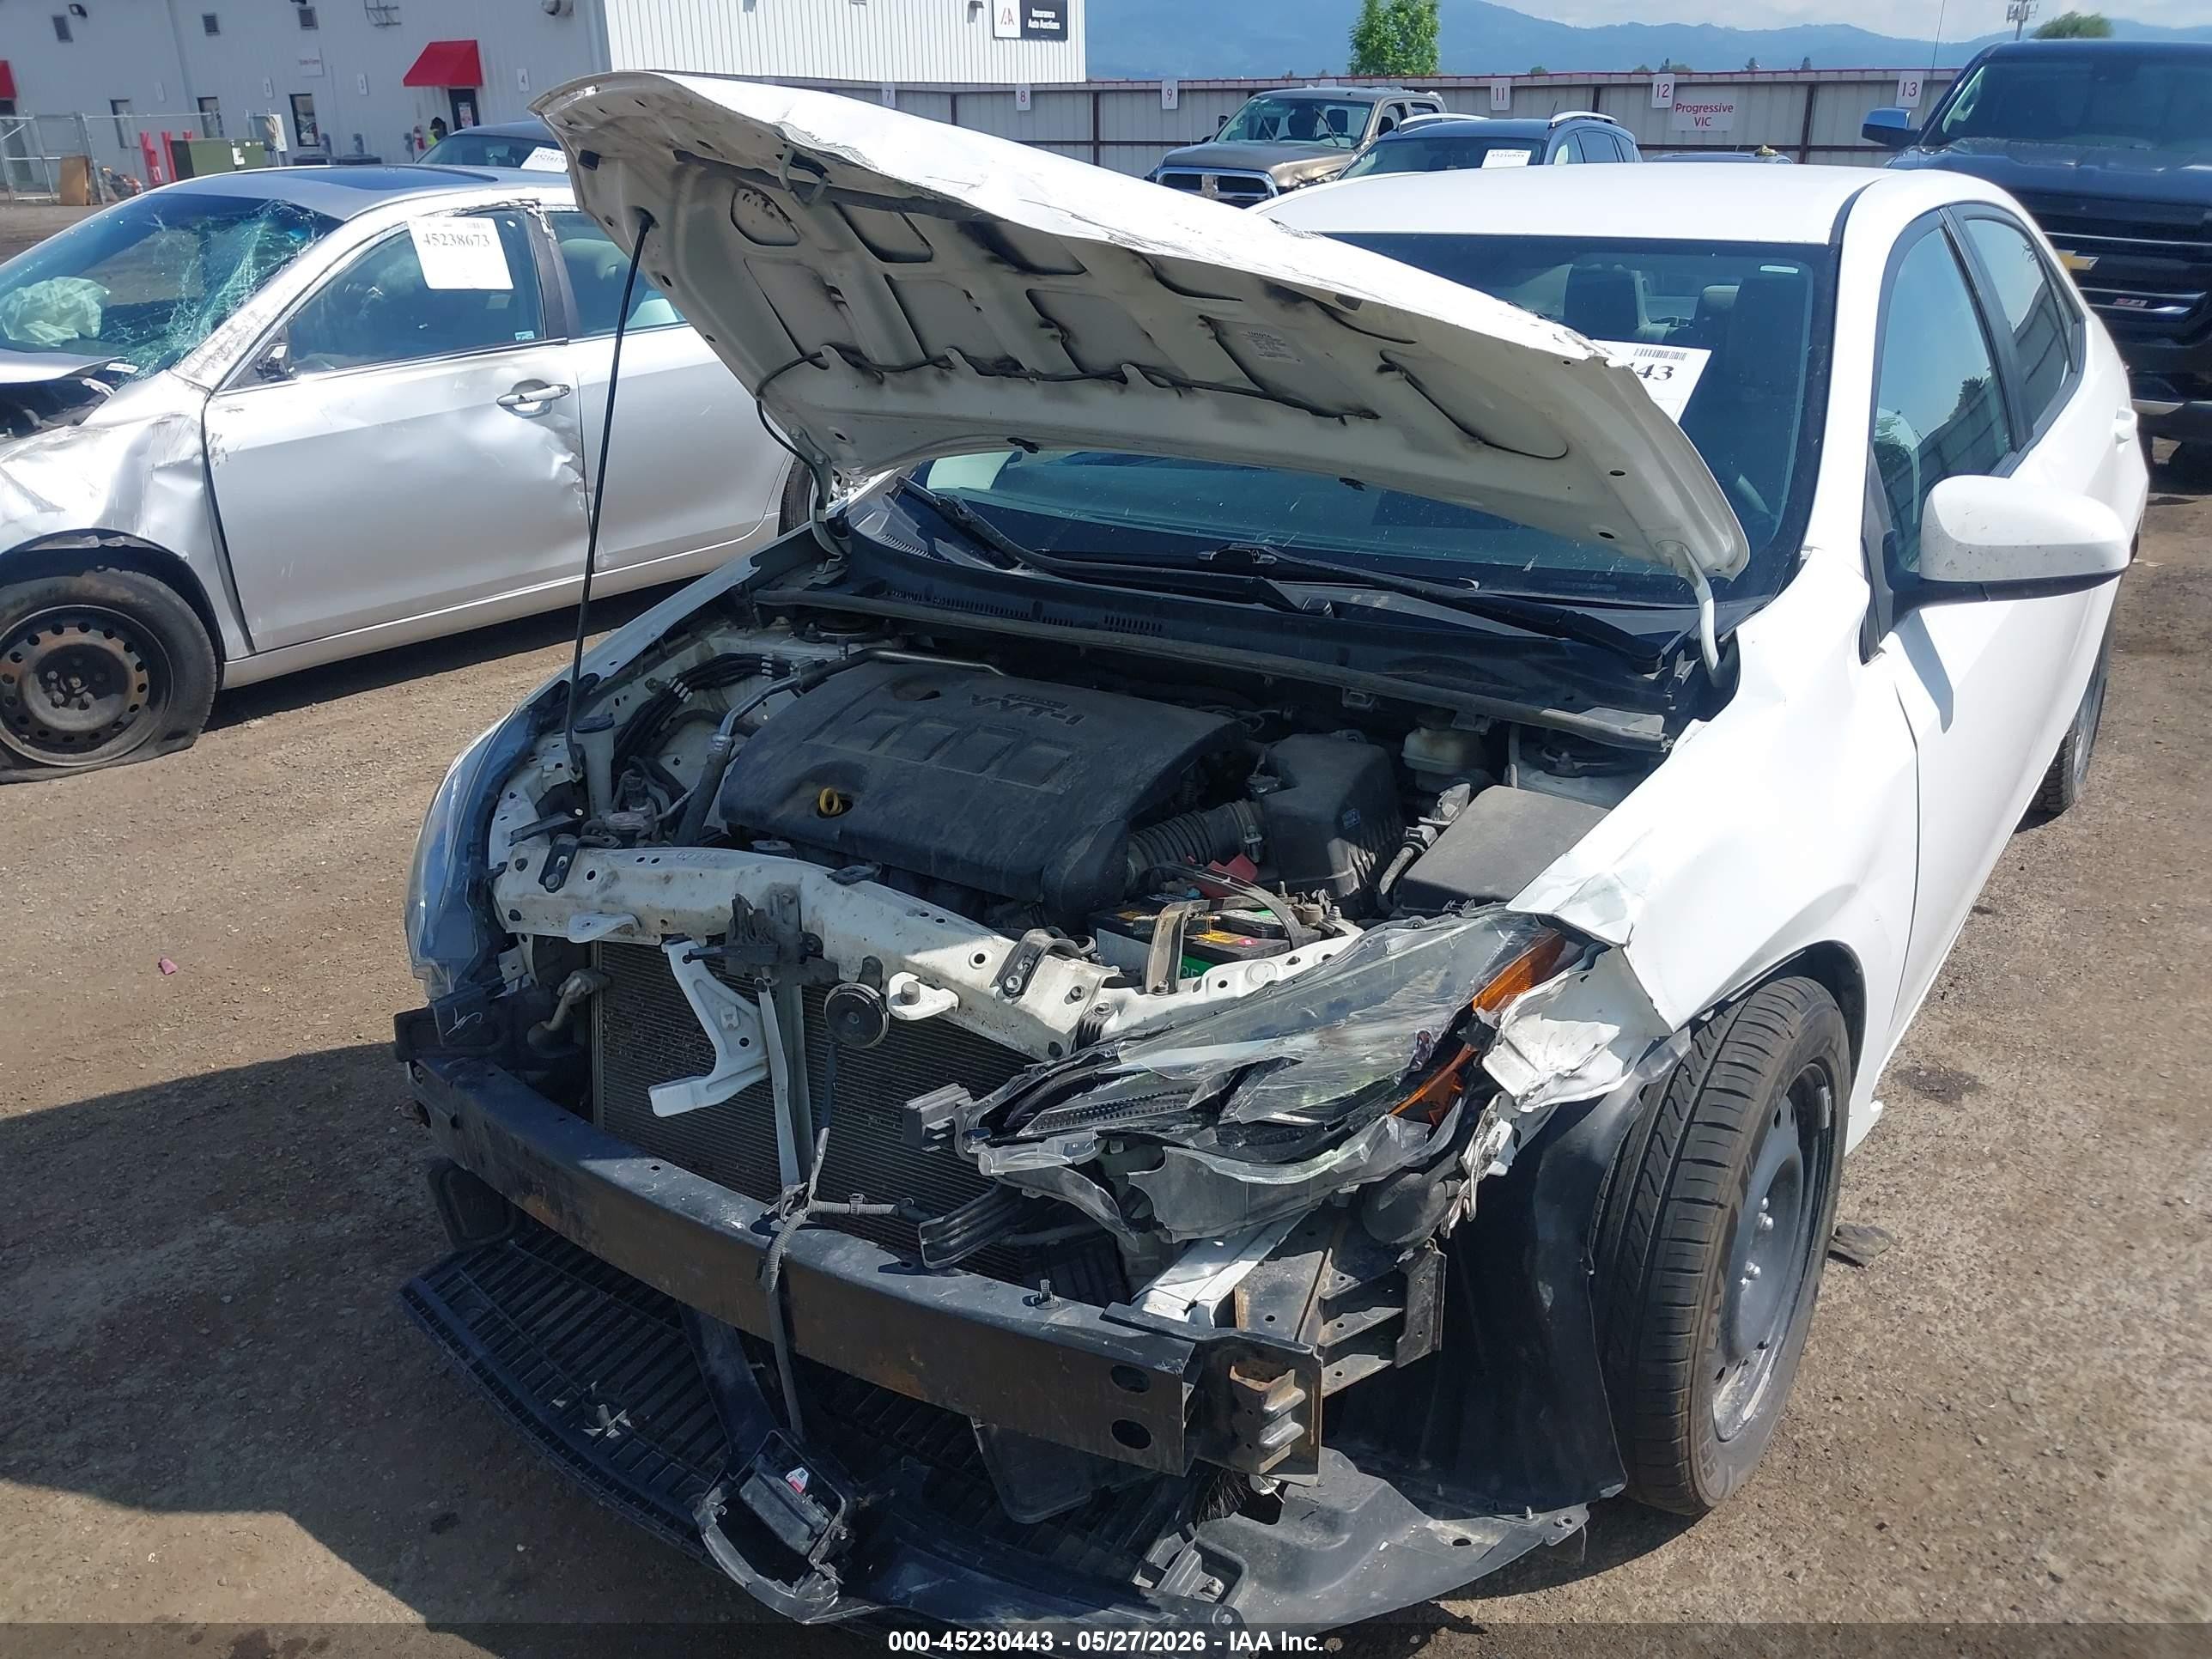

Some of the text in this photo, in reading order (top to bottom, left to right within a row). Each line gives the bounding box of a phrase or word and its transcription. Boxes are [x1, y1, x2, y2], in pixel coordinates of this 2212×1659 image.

[520, 75, 526, 84] 4
[886, 89, 891, 101] 7
[1166, 88, 1173, 101] 9
[1495, 87, 1505, 101] 11
[1656, 83, 1670, 99] 12
[1901, 82, 1918, 97] 13
[1019, 90, 1025, 103] 8
[1674, 102, 1734, 114] Progressive
[1694, 117, 1711, 127] VIC
[422, 232, 490, 247] 45238673
